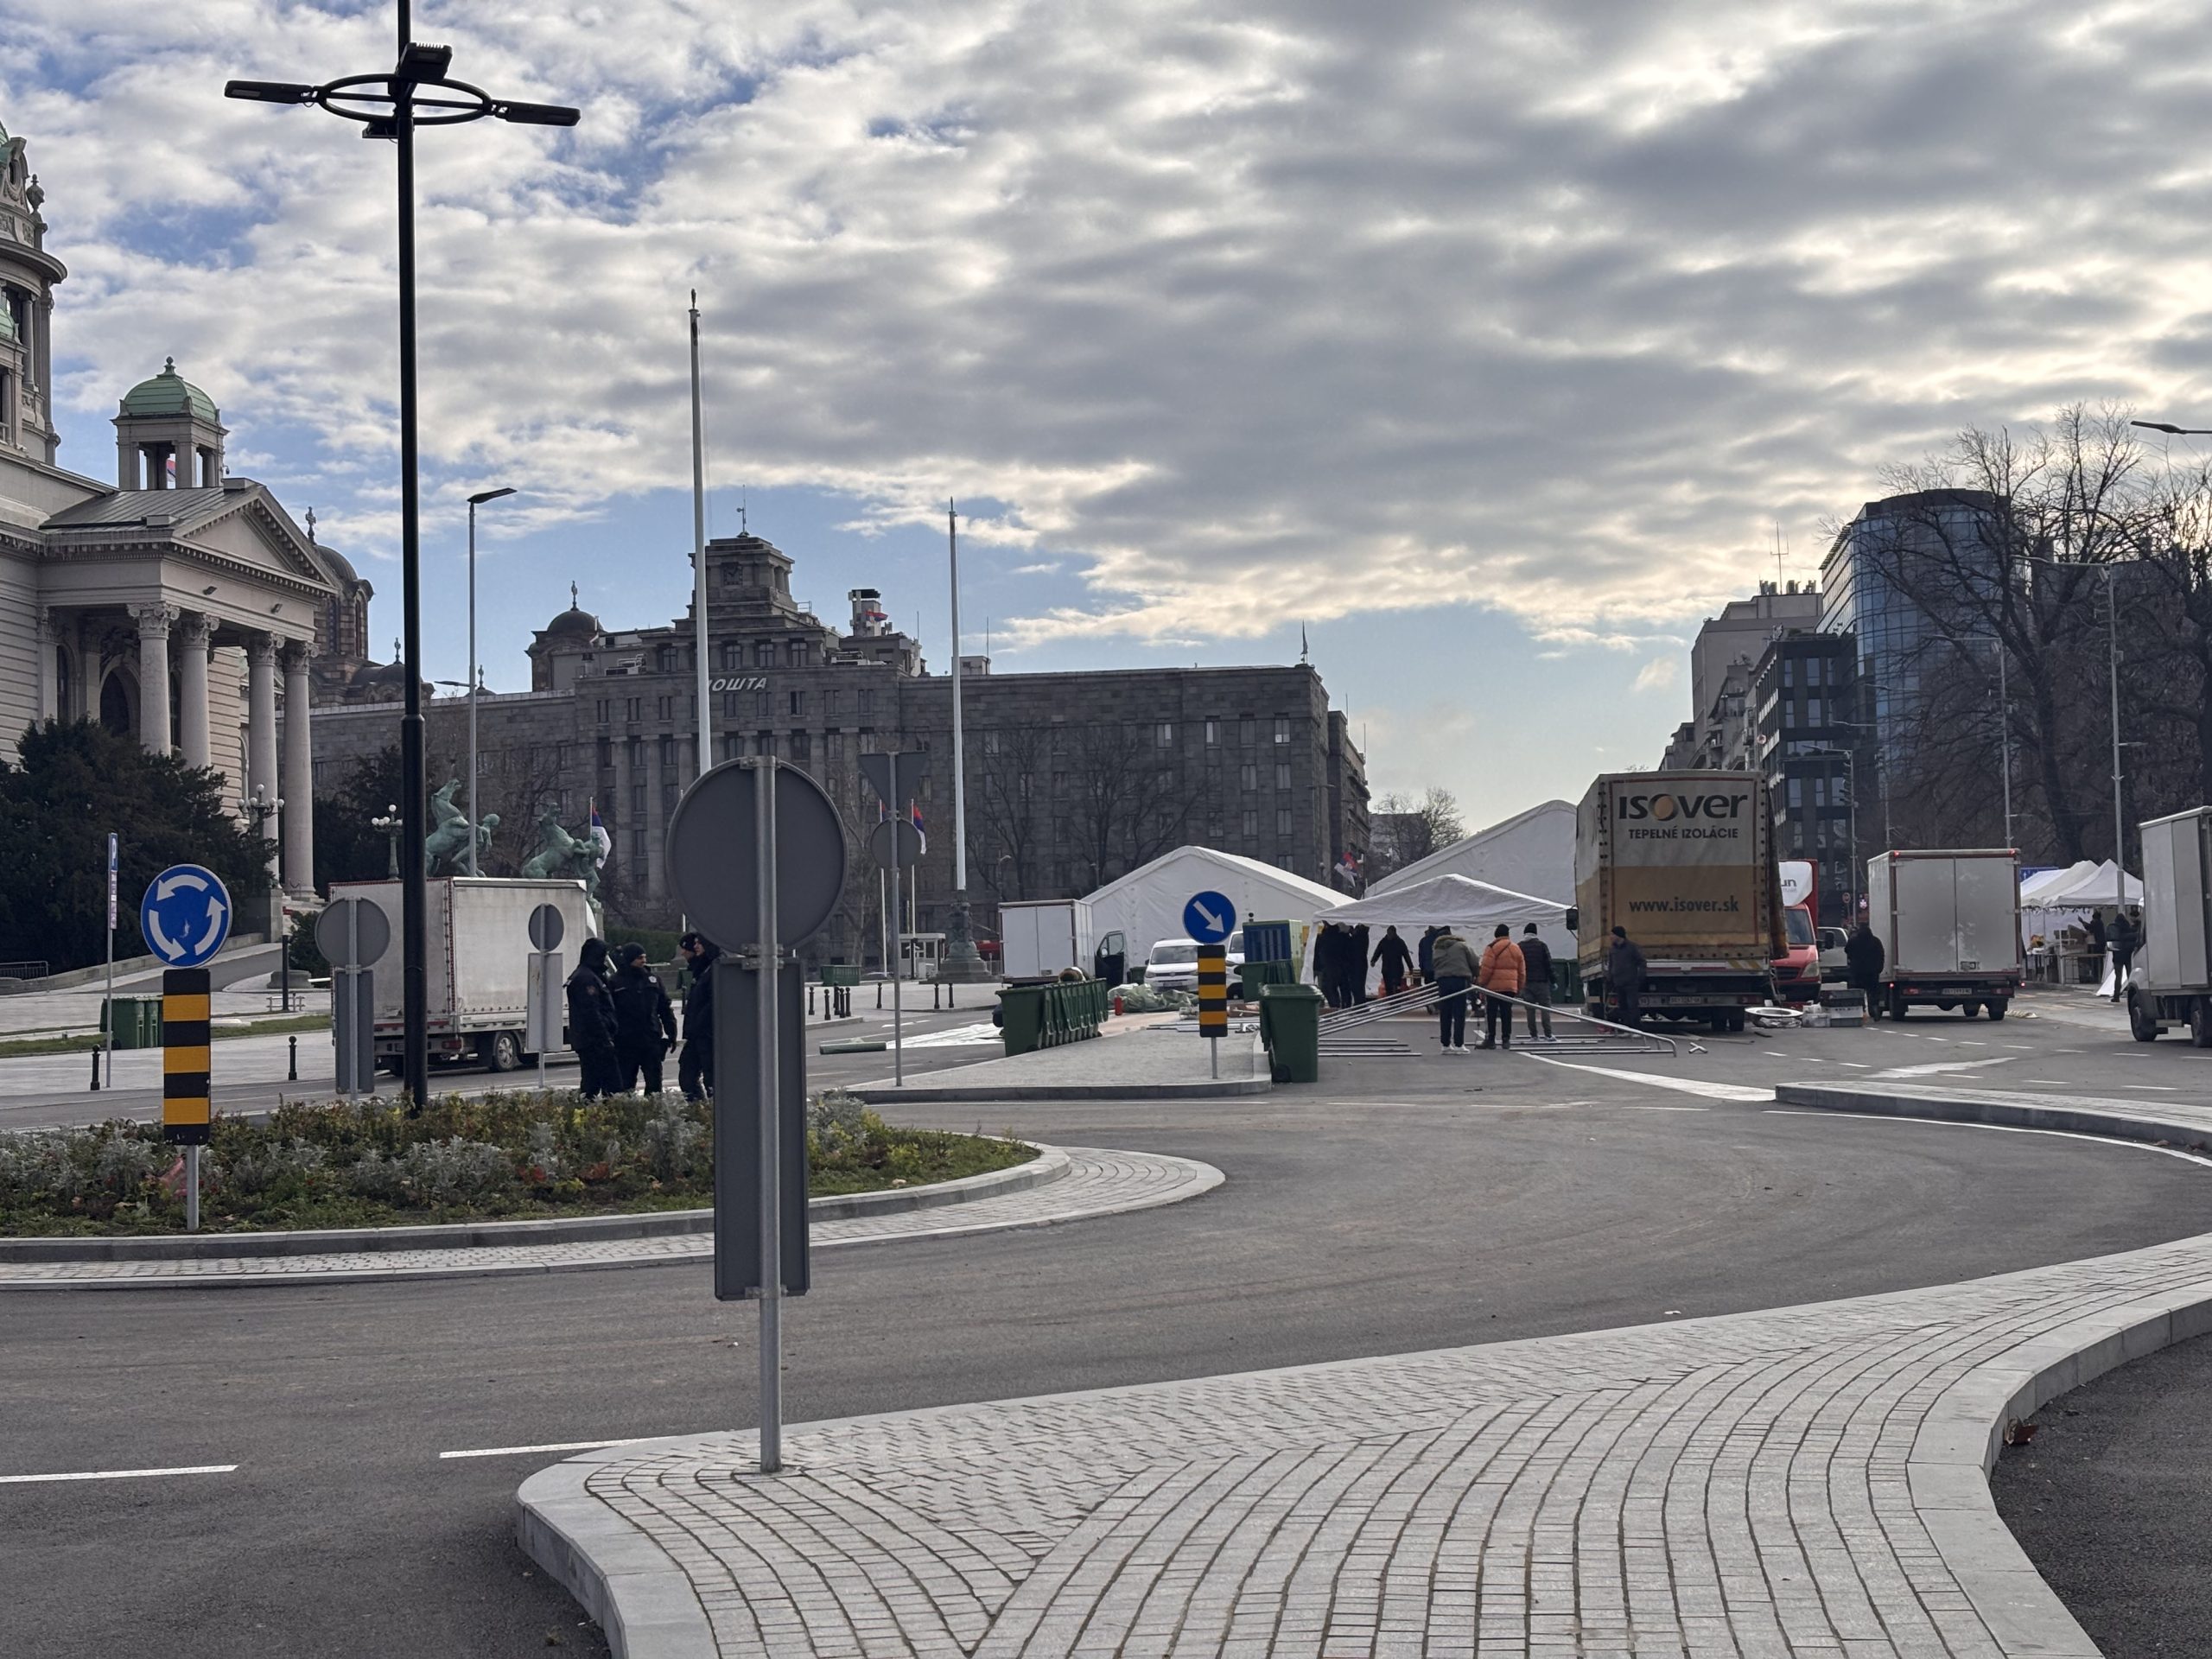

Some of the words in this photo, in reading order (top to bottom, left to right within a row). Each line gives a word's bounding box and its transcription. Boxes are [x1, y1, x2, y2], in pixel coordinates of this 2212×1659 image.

[709, 677, 767, 691] ОШТА
[1629, 826, 1678, 839] TEPELNÉ
[1681, 826, 1738, 839] IZOLÁCIE
[1629, 895, 1739, 912] www.isover.sk
